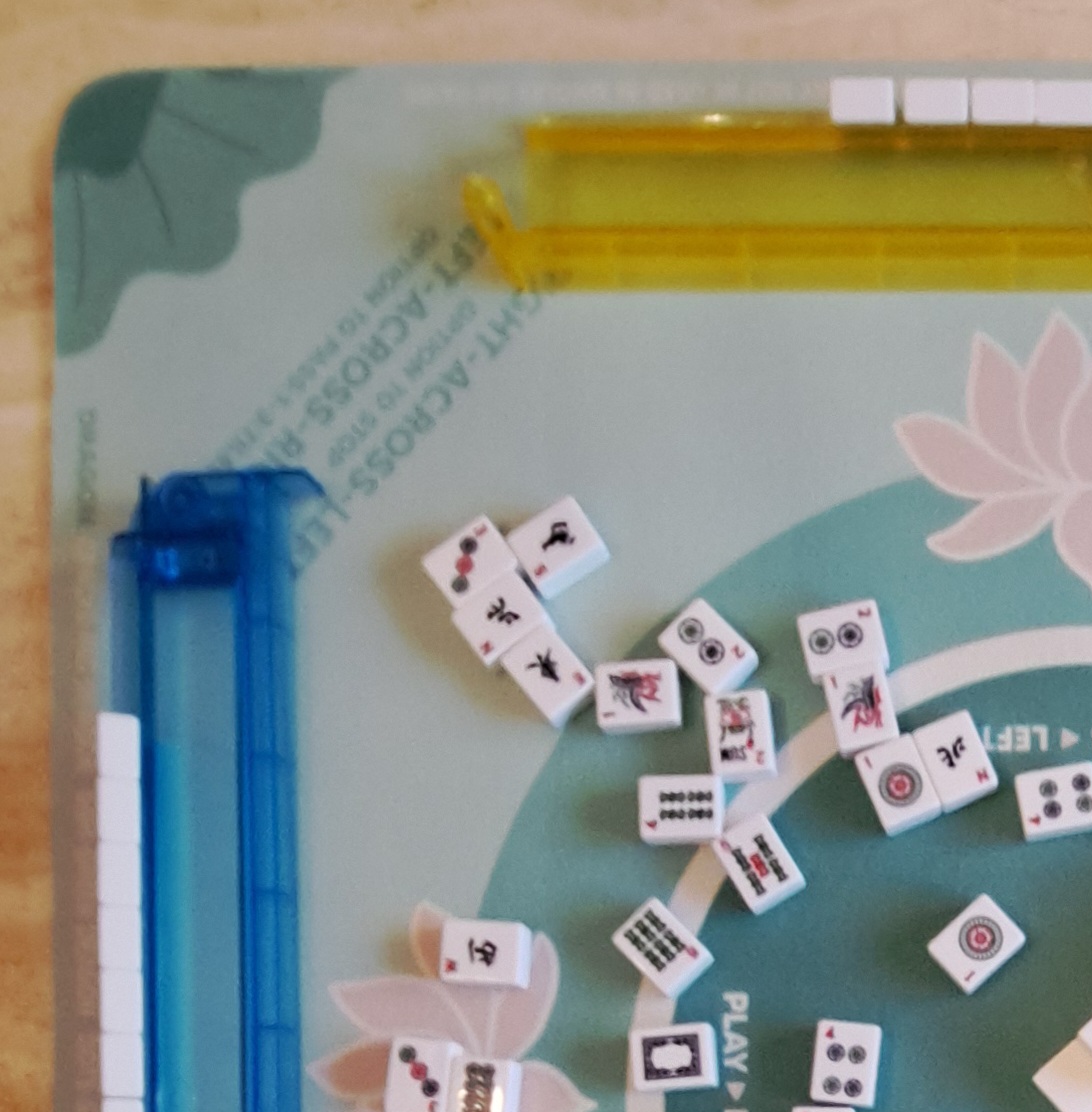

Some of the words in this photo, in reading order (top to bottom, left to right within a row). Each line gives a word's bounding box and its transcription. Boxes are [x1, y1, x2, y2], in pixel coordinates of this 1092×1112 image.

[373, 379, 406, 412] TO
[936, 737, 966, 768] 北
[863, 757, 872, 769] 1
[1030, 816, 1041, 826] 4
[964, 970, 976, 982] 1
[722, 991, 749, 1073] PLAY
[825, 1027, 834, 1039] 4
